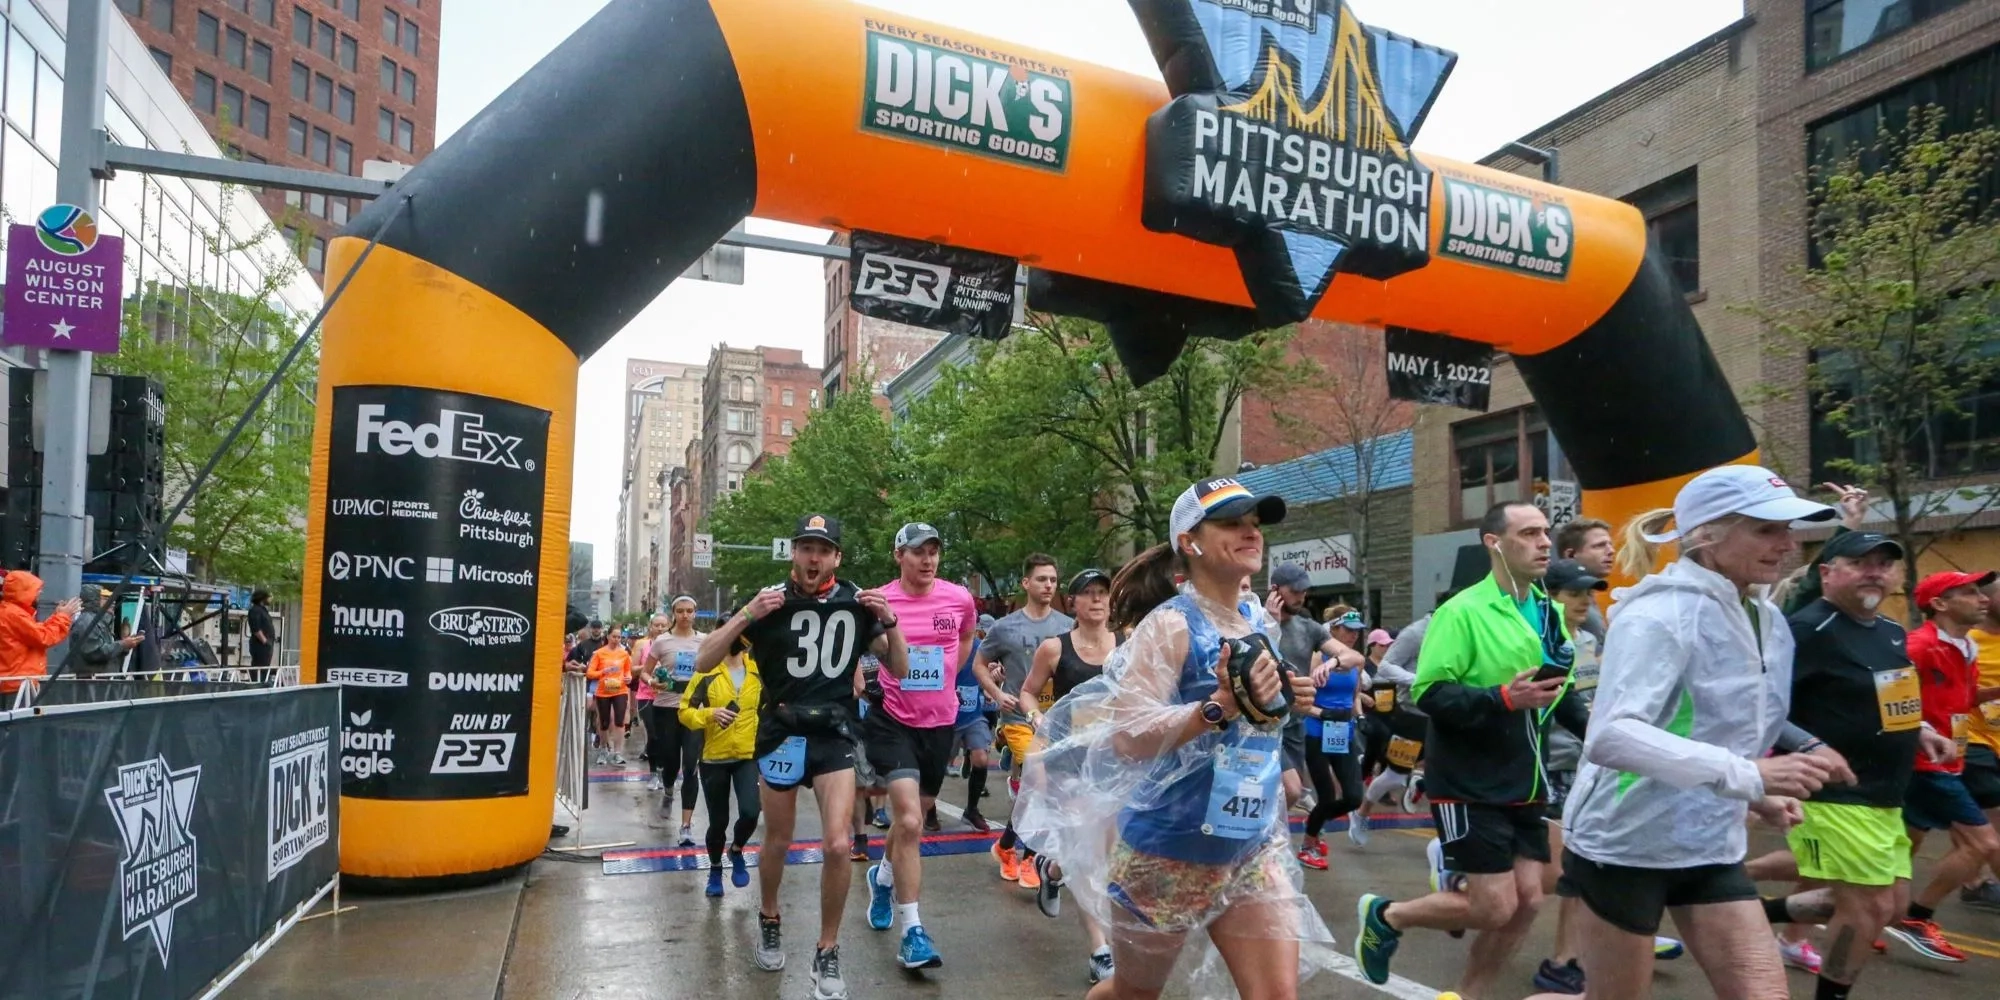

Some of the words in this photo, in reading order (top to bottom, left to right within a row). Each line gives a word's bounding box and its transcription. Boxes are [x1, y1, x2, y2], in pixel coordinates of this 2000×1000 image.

[864, 19, 917, 39] EVERY
[922, 33, 987, 58] SEASON
[990, 51, 1047, 73] STARTS
[1051, 65, 1070, 78] AT
[875, 38, 1063, 142] DICK'S
[875, 108, 981, 146] SPORTING
[988, 134, 1057, 164] GOODS
[1195, 110, 1429, 208] PITTSBURGH
[1192, 154, 1427, 251] MARATHON
[1449, 183, 1569, 259] DICK'S
[25, 258, 105, 279] AUGUST
[1447, 238, 1514, 265] SPORTING
[1517, 254, 1563, 275] GOODS
[25, 273, 105, 294] WILSON
[864, 259, 939, 302] P3R
[958, 275, 982, 287] KEEP
[24, 290, 104, 310] CENTER
[953, 296, 993, 312] RUNNING
[955, 286, 1011, 304] PITTSBURGH
[1388, 352, 1429, 376] MAY
[1433, 360, 1442, 381] 1,
[1447, 363, 1490, 385] 2022
[355, 404, 523, 470] FedEx
[332, 499, 384, 516] UPMC
[391, 500, 430, 510] SPORTS
[391, 509, 438, 520] MEDICINE
[459, 494, 532, 528] Chick-fil-A
[1554, 505, 1573, 523] 25
[460, 523, 534, 548] Pittsburgh
[1282, 549, 1310, 561] Liberty
[1324, 555, 1348, 570] Fish
[353, 555, 415, 580] PNC
[459, 564, 533, 586] Microsoft
[331, 604, 405, 629] nuun
[439, 611, 523, 635] BRUSTER'S
[932, 618, 957, 631] PSRA
[333, 627, 404, 637] HYDRATION
[469, 636, 486, 646] real
[486, 635, 499, 645] ice
[499, 634, 522, 644] cream
[786, 610, 856, 679] 30
[330, 670, 403, 684] SHEETZ
[428, 672, 524, 692] DUNKIN'
[450, 714, 486, 731] RUN
[490, 713, 512, 730] BY
[271, 738, 289, 755] EVERY
[439, 739, 507, 768] P3R
[1327, 737, 1346, 746] 1555
[341, 754, 395, 779] agle
[769, 760, 793, 773] 717
[123, 765, 157, 799] DICK'S
[272, 750, 327, 846] DICK'S
[272, 835, 306, 868] SPORTING
[306, 820, 327, 844] GOODS
[125, 845, 192, 898] PITTSBURGH
[126, 868, 193, 926] MARATHON
